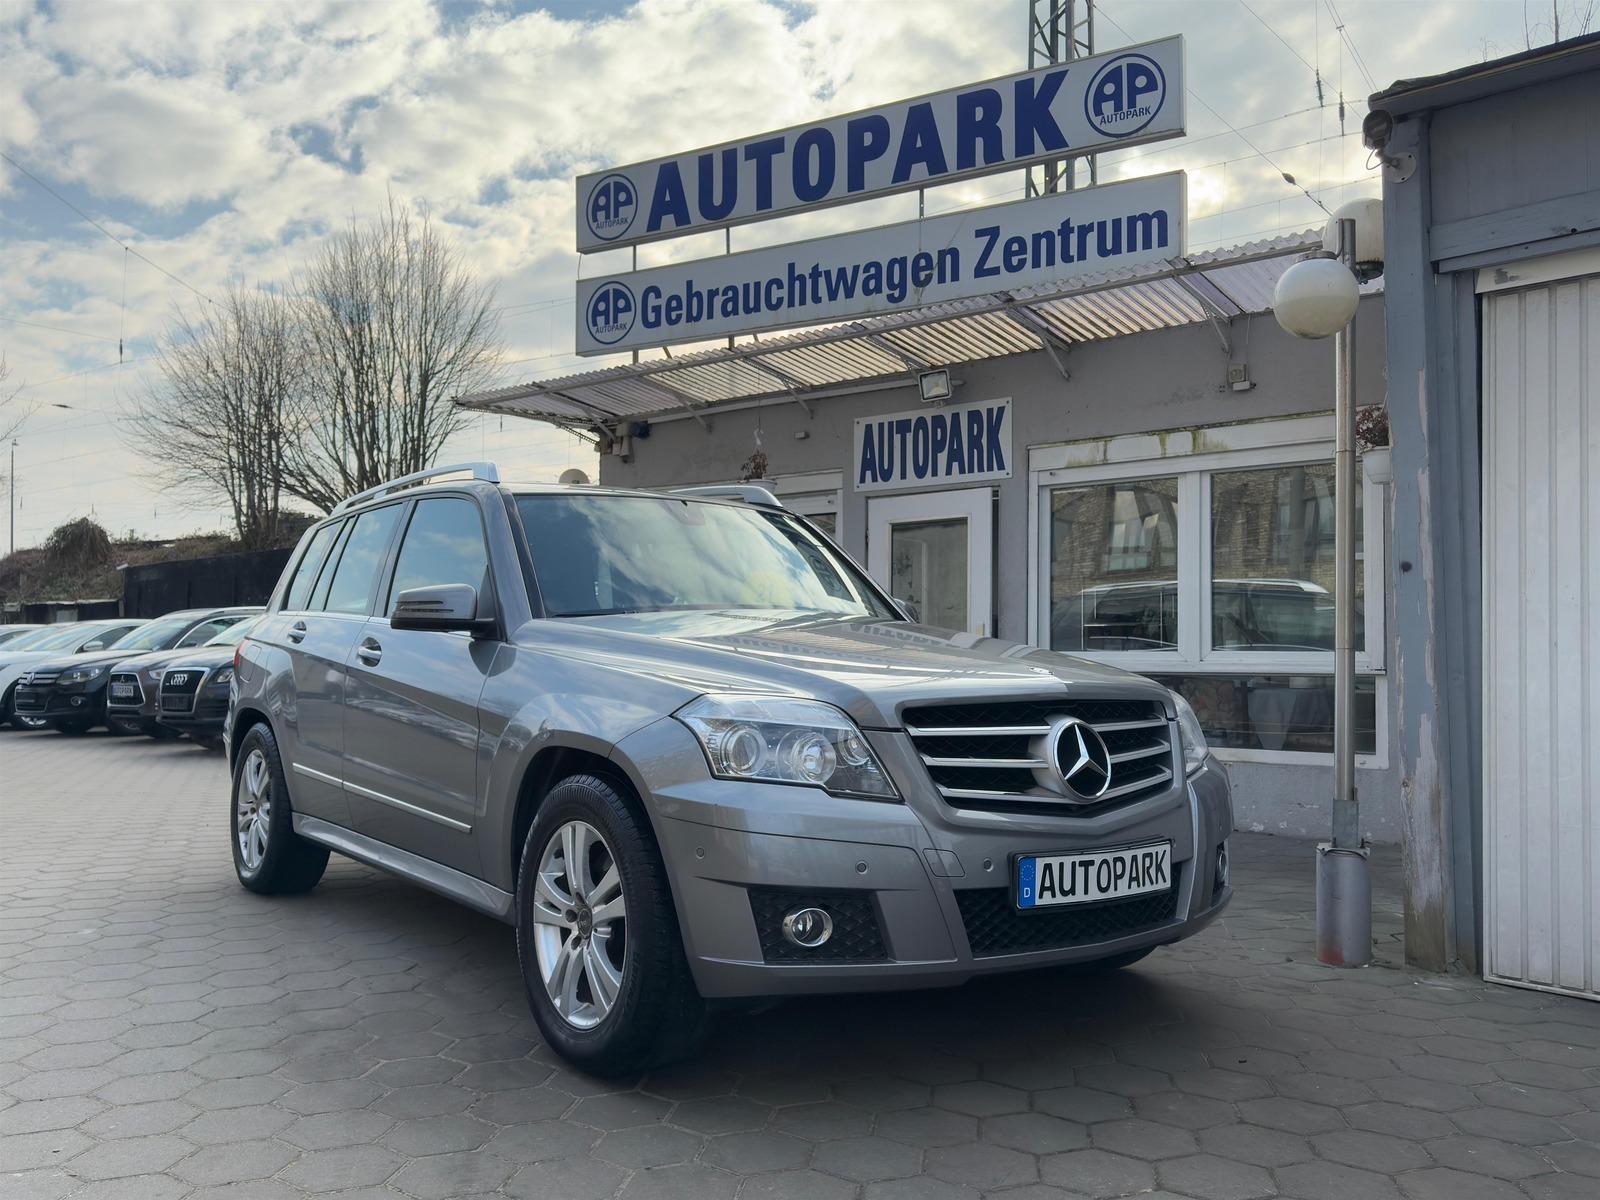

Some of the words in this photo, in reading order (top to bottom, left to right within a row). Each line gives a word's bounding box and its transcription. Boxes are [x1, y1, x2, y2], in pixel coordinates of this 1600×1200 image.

[1093, 64, 1158, 117] AP
[1099, 106, 1152, 125] AUTOPARK
[646, 69, 1070, 232] AUTOPARK
[595, 217, 629, 230] AUTOPARK
[641, 246, 960, 329] Gebrauchtwagen
[973, 209, 1169, 279] Zentrum
[595, 323, 628, 335] AUTOPARK
[859, 406, 1006, 484] AUTOPARK
[1023, 888, 1031, 897] D
[1038, 850, 1167, 899] AUTOPARK
